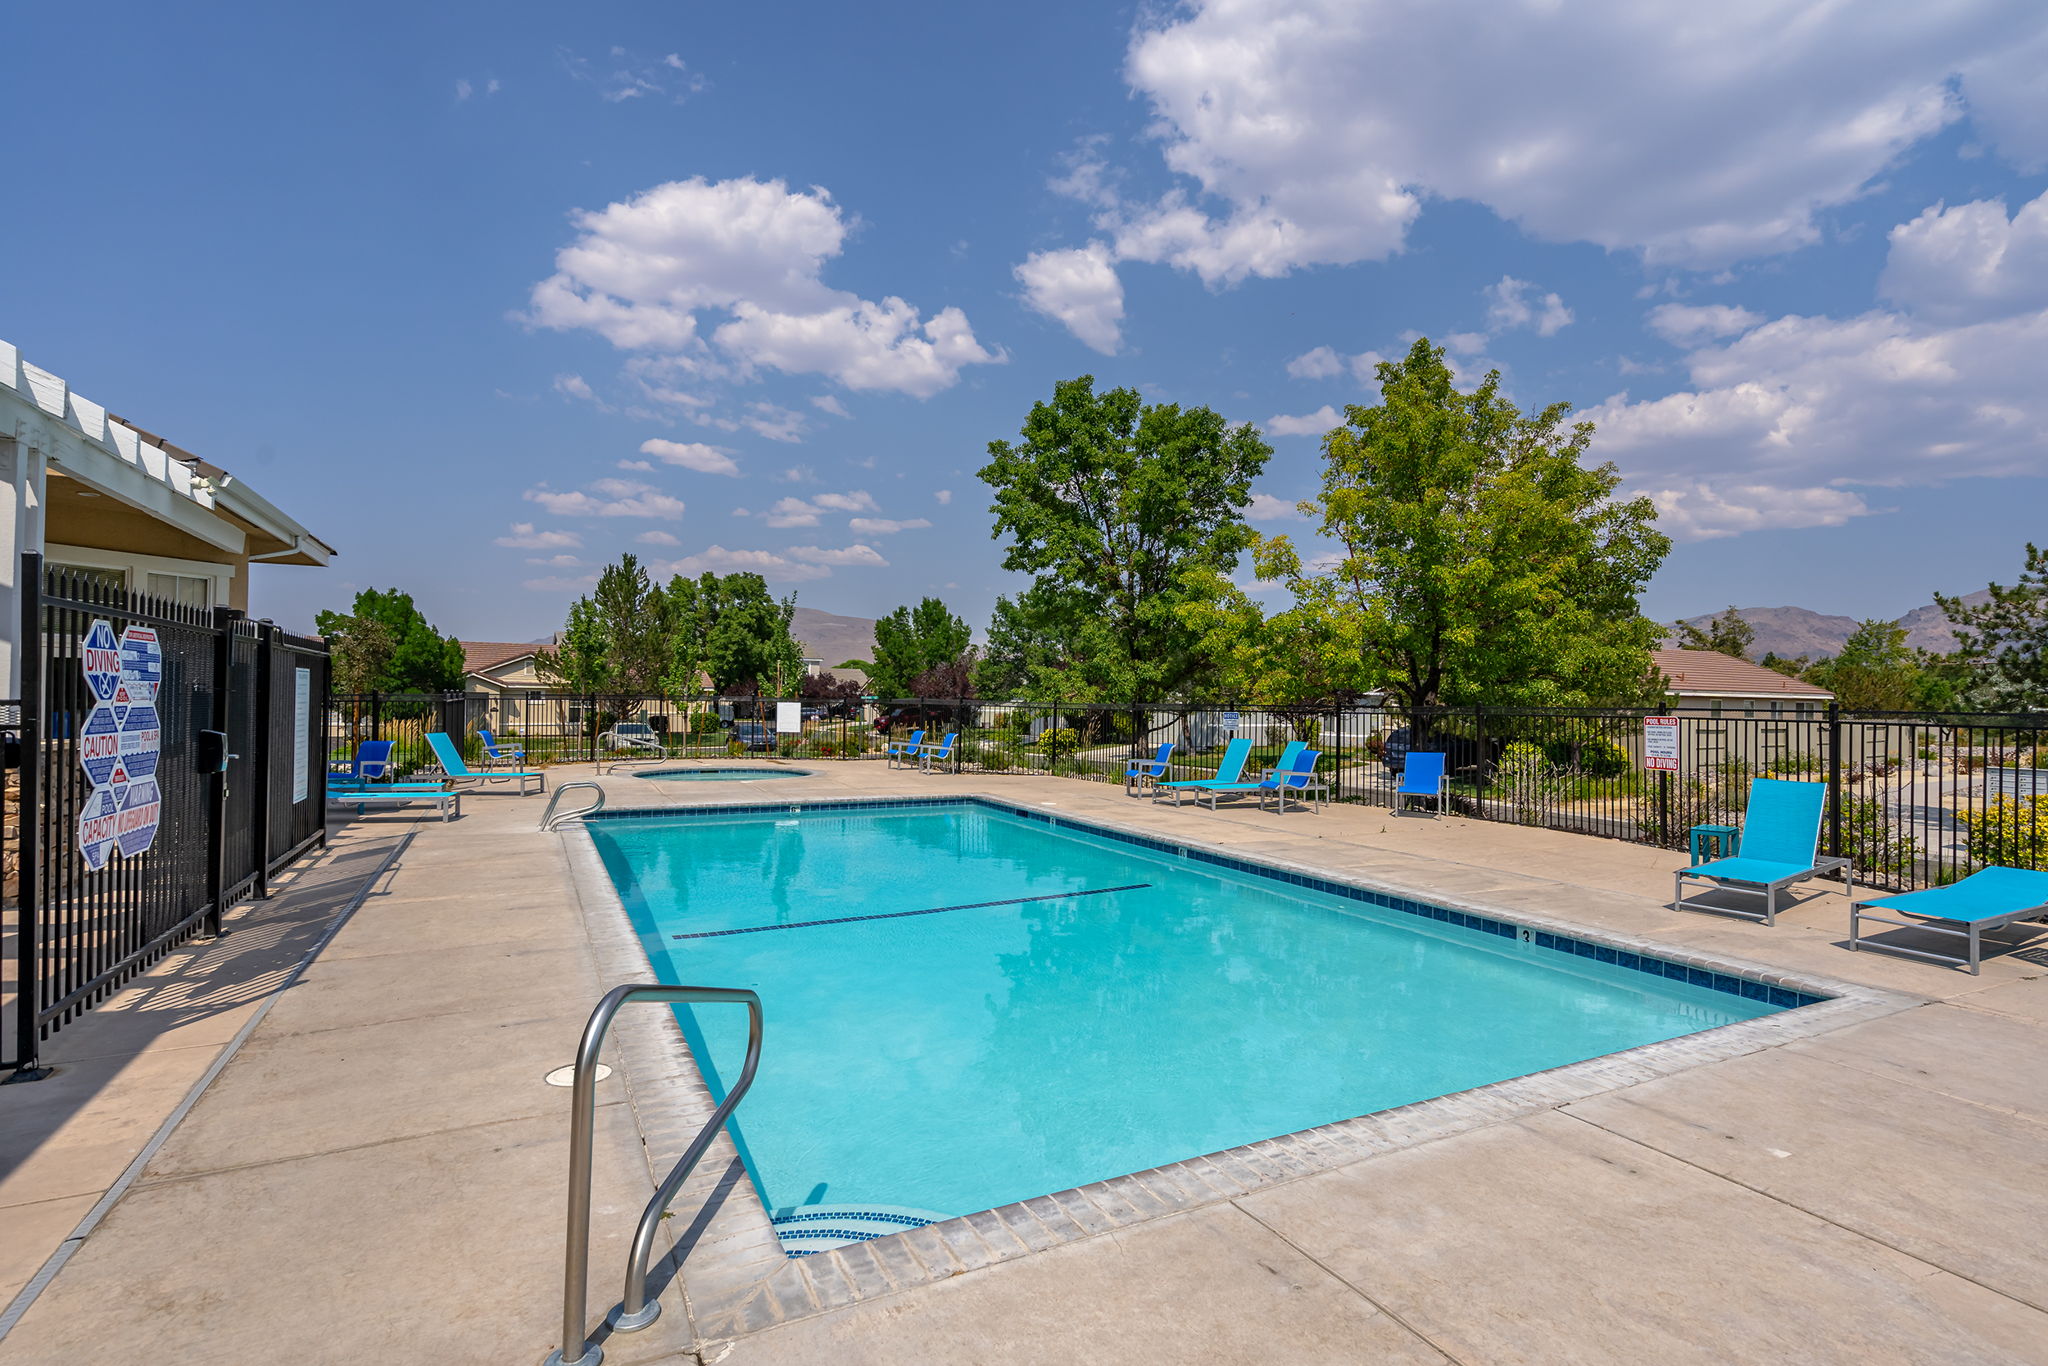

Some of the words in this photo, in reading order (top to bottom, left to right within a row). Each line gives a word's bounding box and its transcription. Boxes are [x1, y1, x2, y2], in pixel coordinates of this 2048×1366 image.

[97, 625, 110, 649] NO
[86, 649, 120, 673] DIVING
[1660, 718, 1676, 726] RULES
[83, 735, 118, 759] CAUTION
[141, 731, 151, 742] POOL
[1646, 757, 1655, 768] NO
[1655, 758, 1677, 770] DIVING
[129, 782, 154, 807] WARNING
[102, 803, 115, 816] POOL
[83, 814, 115, 845] CAPACITY
